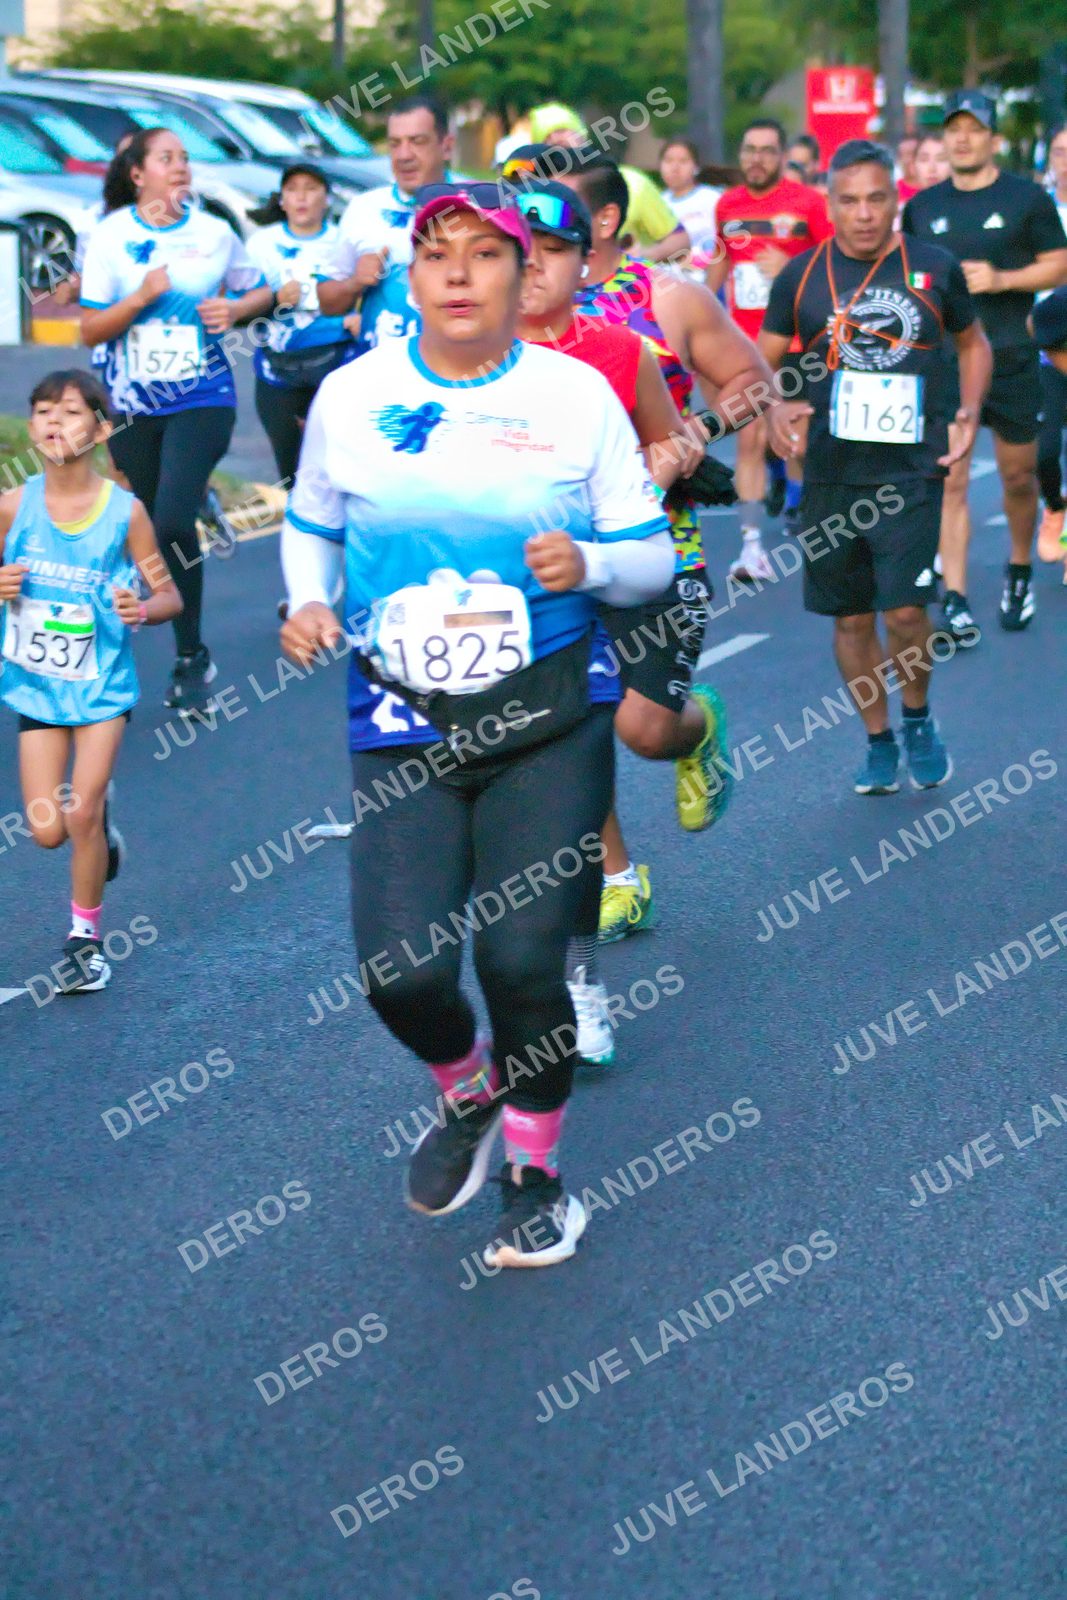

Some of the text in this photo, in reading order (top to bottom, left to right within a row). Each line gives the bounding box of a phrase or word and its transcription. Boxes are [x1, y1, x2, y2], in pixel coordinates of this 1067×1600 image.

[132, 349, 195, 375] 1575
[843, 401, 914, 434] 1162
[12, 623, 95, 670] 1537
[392, 629, 525, 682] 1825
